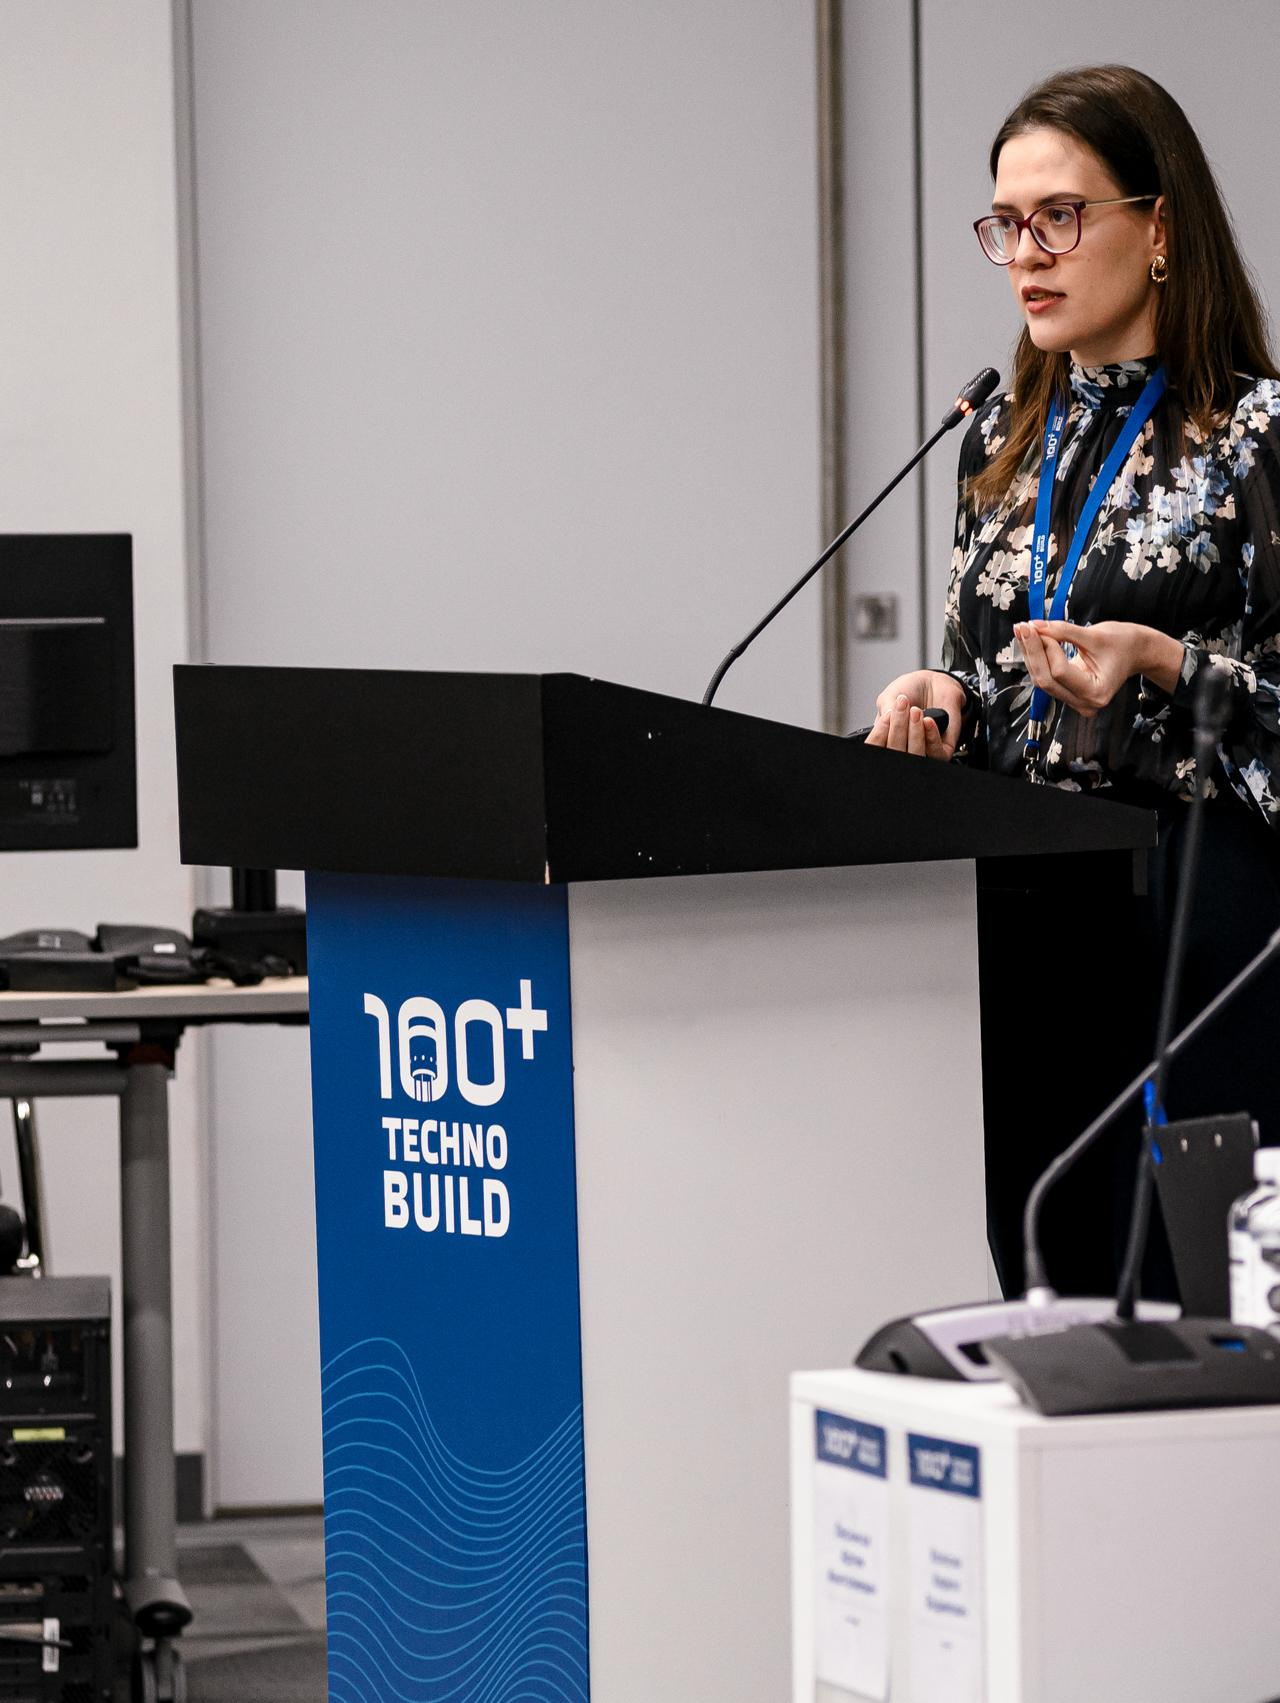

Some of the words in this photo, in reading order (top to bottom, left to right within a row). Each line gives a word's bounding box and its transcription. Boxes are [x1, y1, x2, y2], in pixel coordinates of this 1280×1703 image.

[1033, 554, 1044, 585] 100+
[364, 979, 548, 1106] 100+
[381, 1116, 508, 1170] TECHNO
[383, 1170, 510, 1238] BUILD
